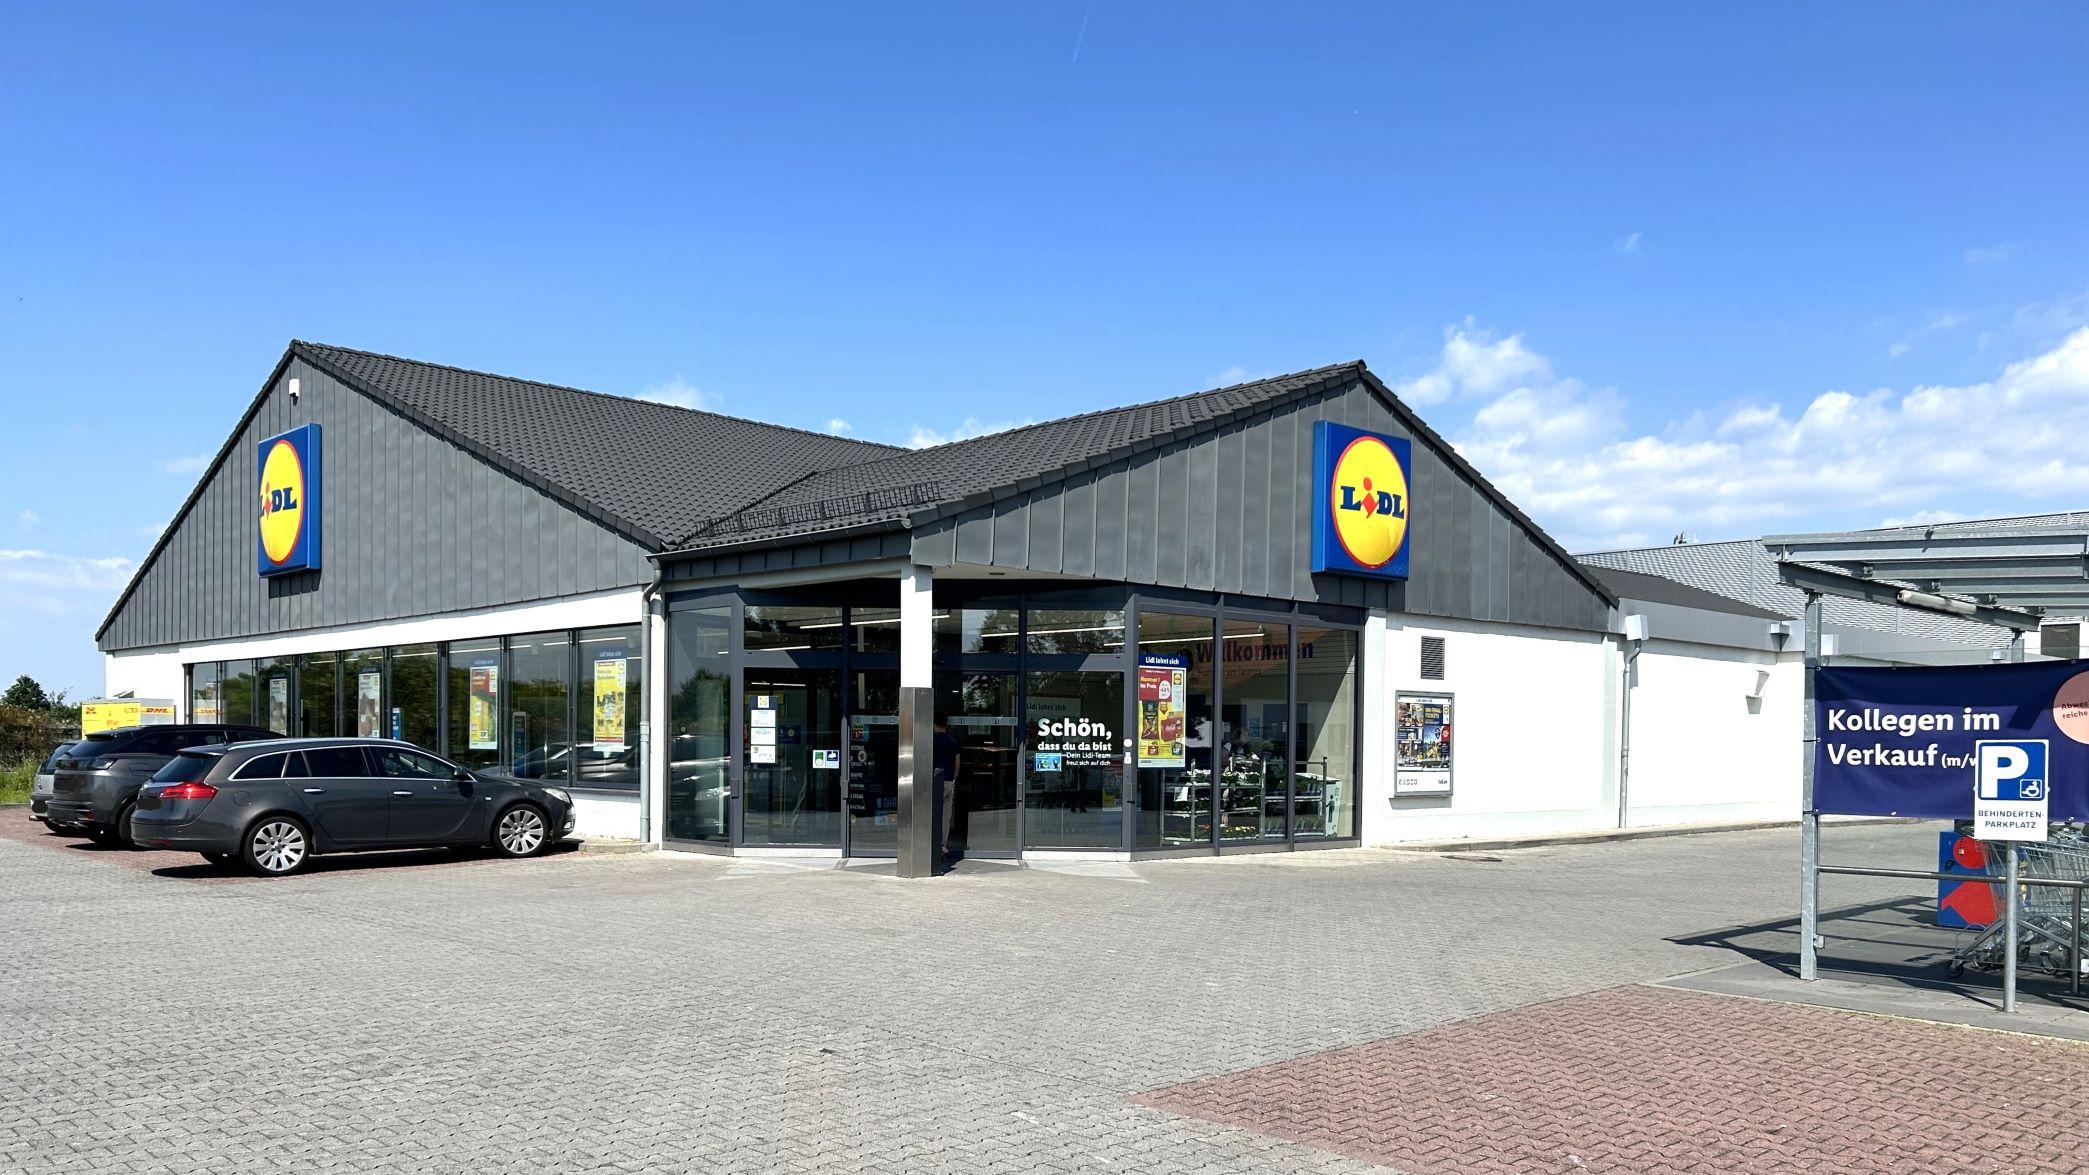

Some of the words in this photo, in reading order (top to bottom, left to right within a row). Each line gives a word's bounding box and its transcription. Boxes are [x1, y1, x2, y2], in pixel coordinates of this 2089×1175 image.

[1145, 656, 1155, 664] Lidl
[2062, 710, 2088, 719] reiche
[1828, 709, 1954, 737] Kollegen
[1963, 707, 2000, 731] im
[1037, 718, 1112, 740] Schön,
[1037, 742, 1060, 751] dass
[1062, 742, 1076, 751] du
[1077, 742, 1091, 751] da
[1092, 742, 1112, 751] bist
[1827, 743, 1939, 766] Verkauf
[1981, 745, 2029, 798] P
[1978, 810, 2045, 818] BEHINDERTEN-
[1985, 820, 2036, 829] PARKPLATZ
